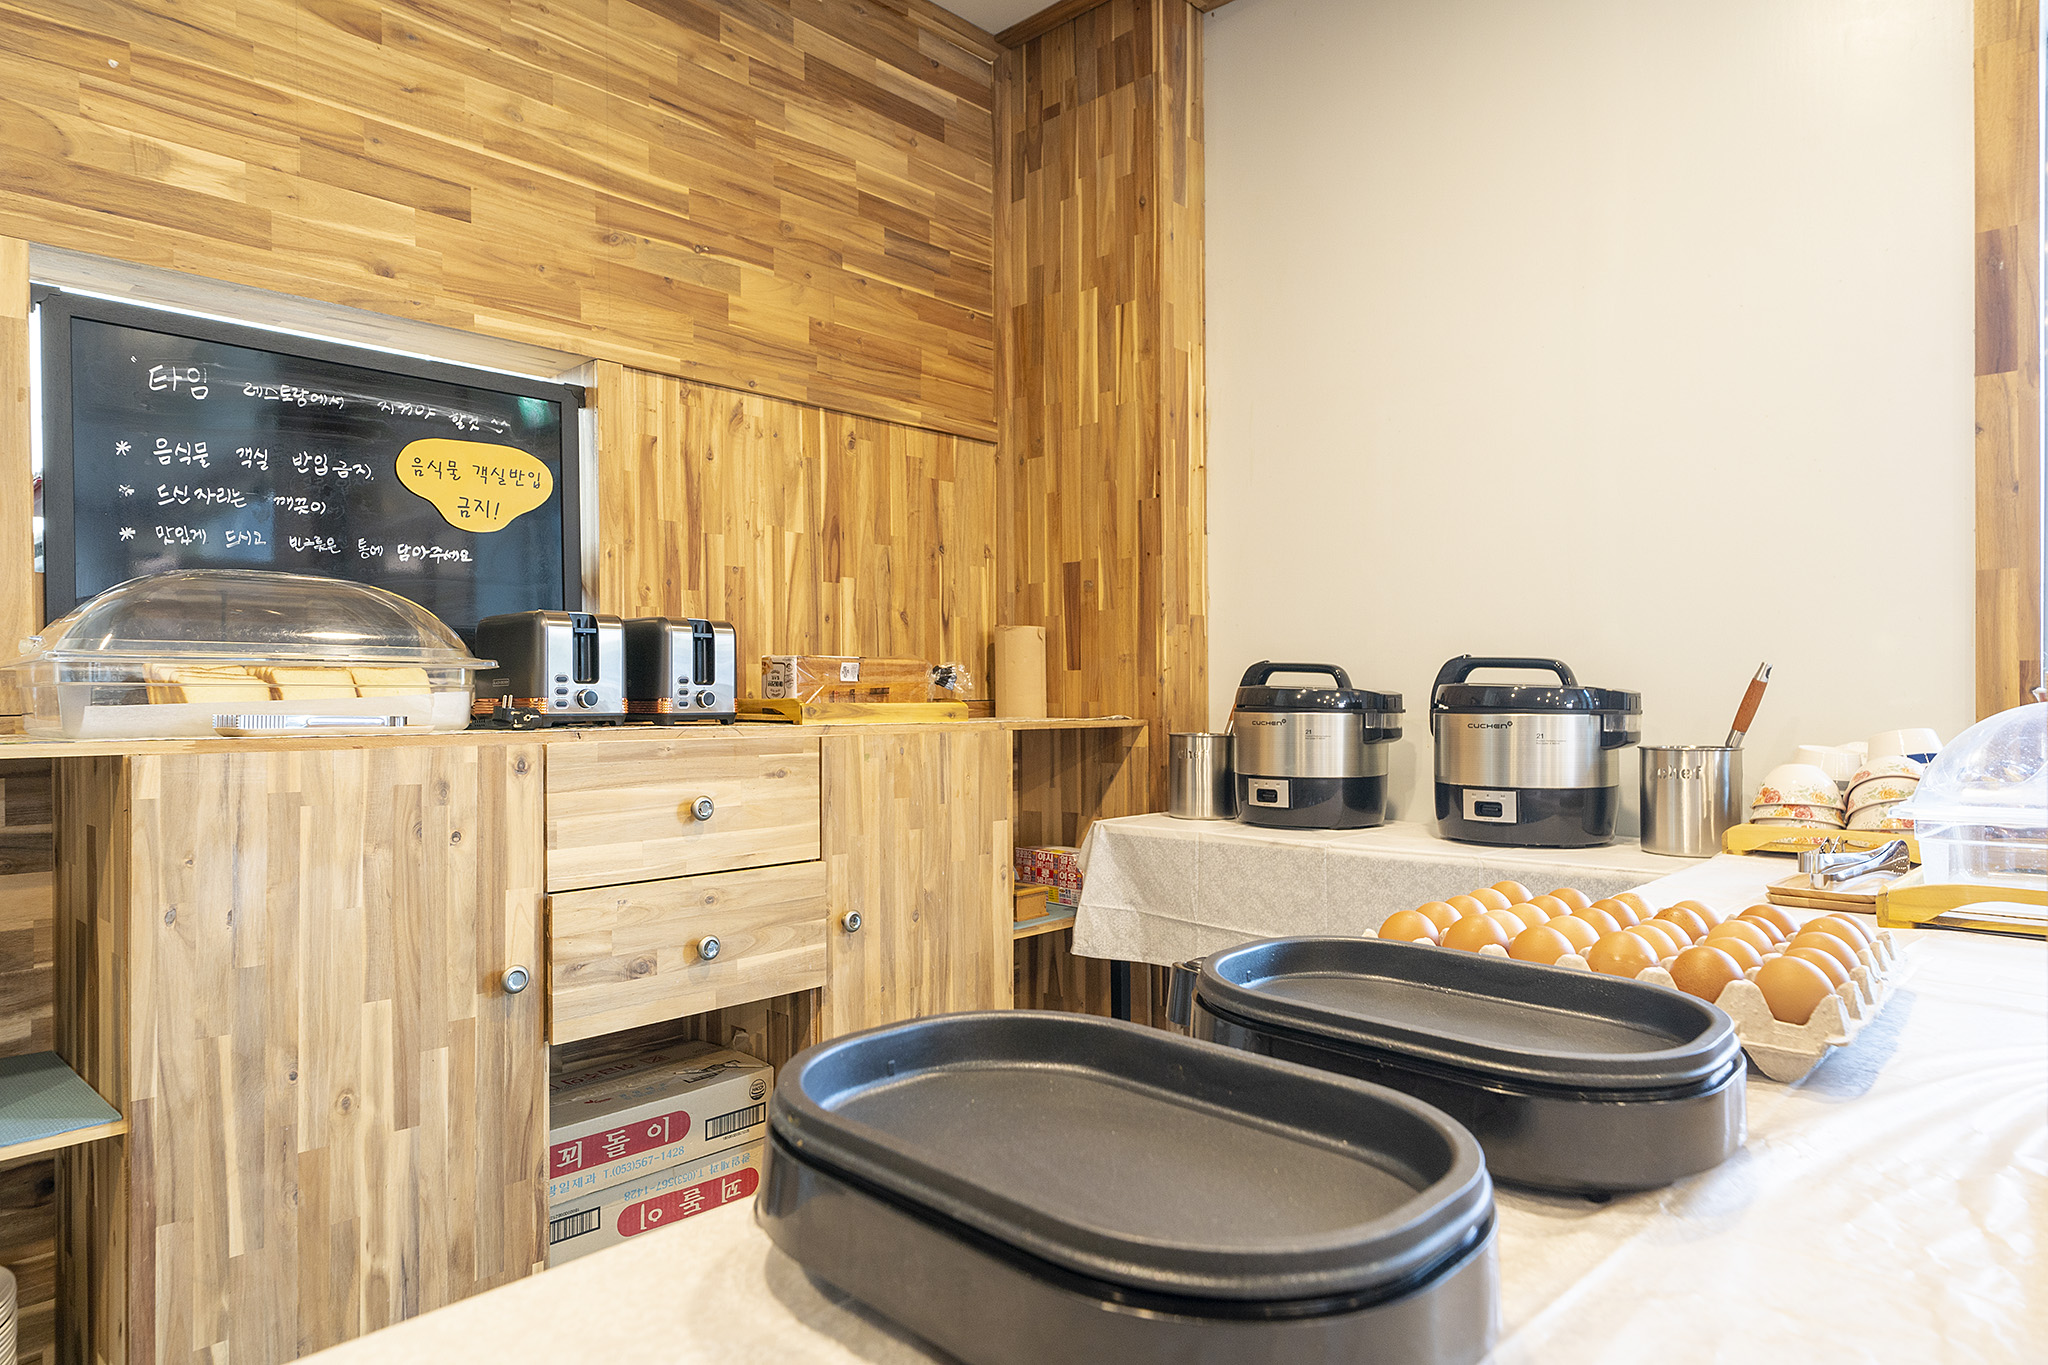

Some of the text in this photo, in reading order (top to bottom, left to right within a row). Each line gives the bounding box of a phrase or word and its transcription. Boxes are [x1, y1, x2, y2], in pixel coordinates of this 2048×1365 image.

[148, 365, 208, 400] 타임
[243, 383, 345, 409] 레스토랑에서
[377, 401, 436, 419] 지켜야
[153, 438, 210, 468] 음식물
[235, 447, 269, 471] 객실
[411, 457, 461, 481] 음식물
[274, 495, 327, 515] 깨끗이
[457, 497, 500, 520] 금지!
[155, 525, 206, 545] 맛있게
[225, 531, 267, 549] 드시고
[357, 538, 384, 560] 통에
[397, 544, 473, 564] 담아주세요
